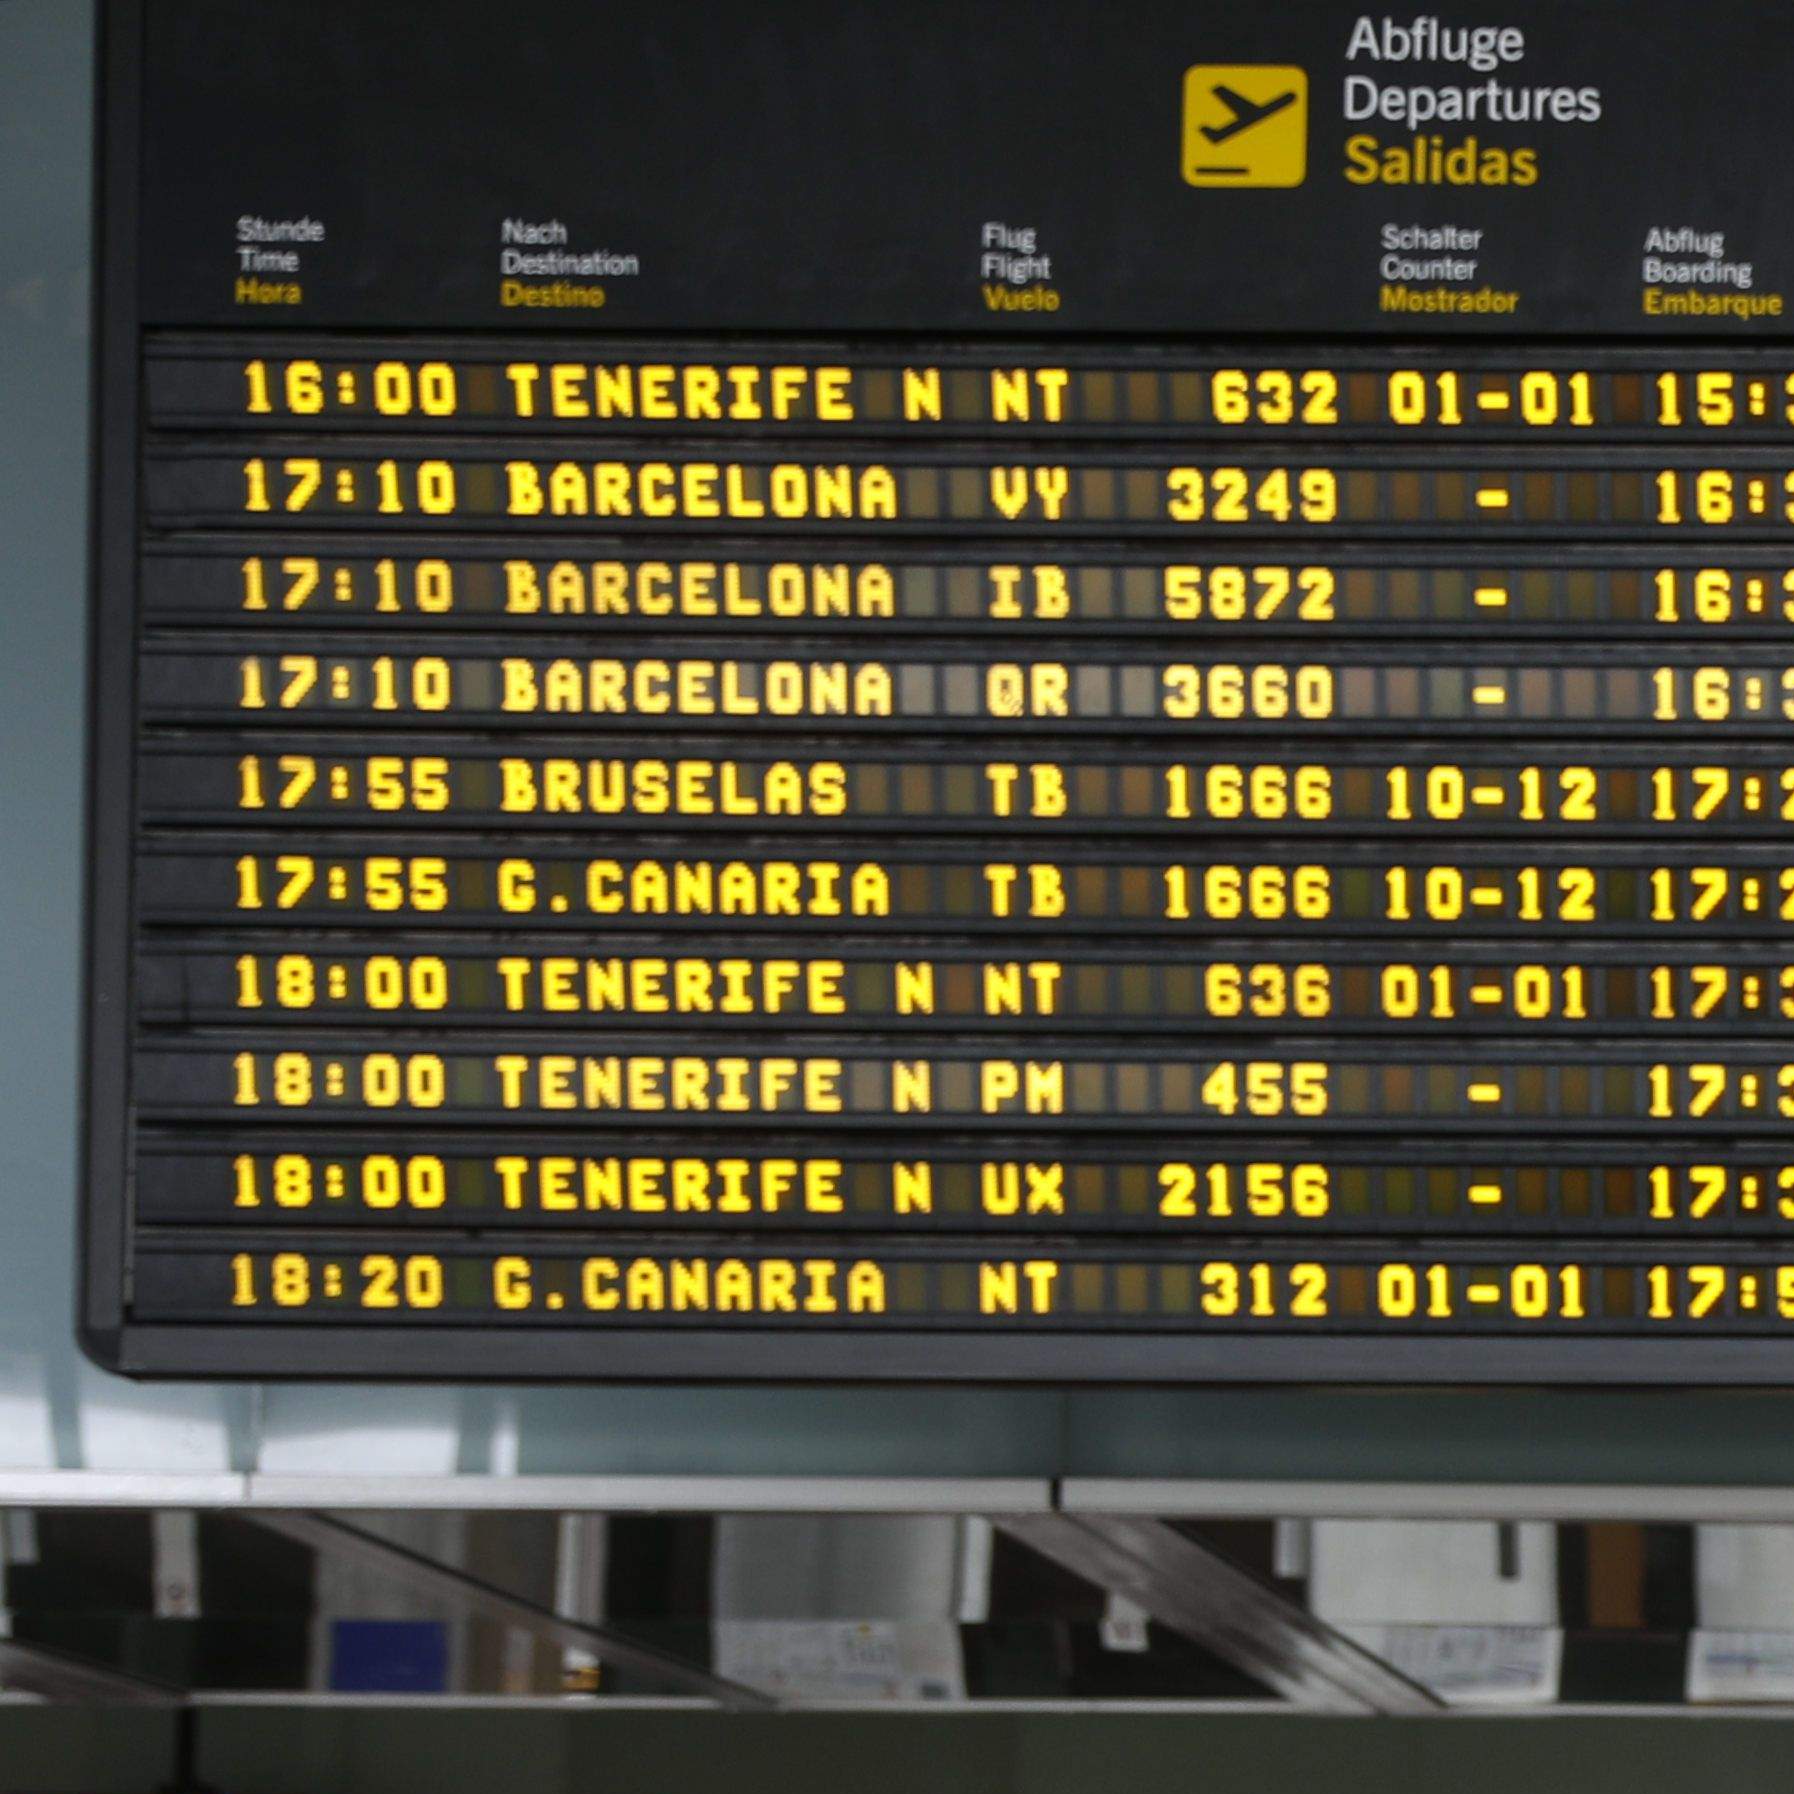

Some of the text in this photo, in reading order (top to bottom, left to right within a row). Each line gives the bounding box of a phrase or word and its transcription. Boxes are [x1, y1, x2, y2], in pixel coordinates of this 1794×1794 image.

[1345, 15, 1525, 72] Abfluge
[1342, 75, 1602, 131] Departures
[1343, 133, 1540, 187] Salidas
[236, 215, 325, 242] Stunde
[501, 217, 568, 245] Nach
[981, 222, 1037, 254] Flug
[1381, 224, 1483, 250] Schalter
[1644, 227, 1725, 256] Abflug
[236, 245, 299, 272] Time
[501, 248, 640, 275] Destination
[981, 253, 1051, 284] Flight
[1380, 253, 1478, 280] Counter
[1643, 257, 1753, 287] Boarding
[235, 276, 302, 305] Hora
[501, 278, 606, 308] Destino
[982, 285, 1060, 311] Vuelo
[1380, 284, 1520, 313] Mostrador
[1643, 289, 1783, 319] Embarque
[245, 362, 455, 415] 16:00
[505, 365, 852, 420] TENERIFE
[902, 371, 940, 420] N
[990, 370, 1067, 421] NT
[1210, 371, 1336, 423] 632
[1387, 372, 1592, 425] 01-01
[240, 658, 449, 710] 17:10
[501, 660, 891, 715] BARCELONA
[1161, 665, 1332, 718] 3660
[240, 758, 448, 810] 17:55
[500, 760, 845, 815] BRUSELAS
[985, 765, 1066, 816] TB
[1164, 766, 1331, 818] 1666
[1385, 767, 1596, 820] 10-12
[236, 956, 446, 1009] 18:00
[496, 959, 844, 1013] TENERIFE
[894, 964, 933, 1013] N
[982, 963, 1060, 1014] NT
[1204, 965, 1329, 1016] 636
[1380, 966, 1584, 1017] 01-01
[235, 1156, 444, 1208] 18:00
[493, 1158, 842, 1212] TENERIFE
[892, 1163, 930, 1213] N
[981, 1164, 1062, 1214] UX
[1157, 1164, 1328, 1216] 2156
[233, 1256, 441, 1307] 18:20
[493, 1258, 884, 1312] G.CANARIA
[978, 1262, 1056, 1313] NT
[1199, 1263, 1326, 1315] 312
[1376, 1265, 1582, 1317] 01-01
